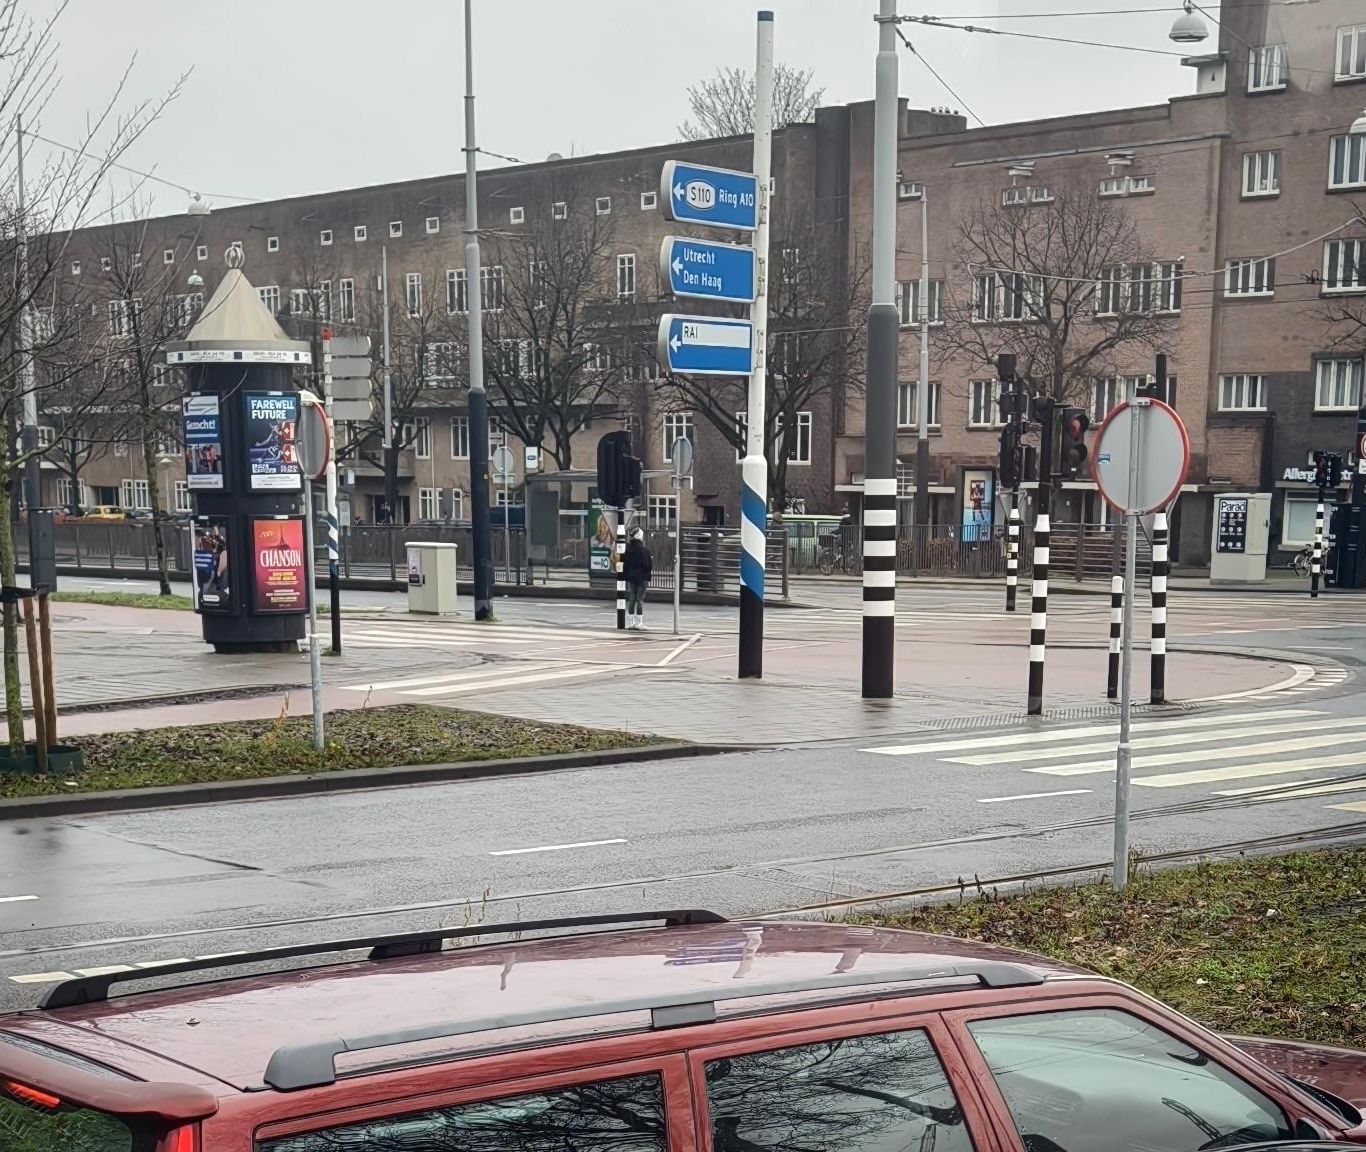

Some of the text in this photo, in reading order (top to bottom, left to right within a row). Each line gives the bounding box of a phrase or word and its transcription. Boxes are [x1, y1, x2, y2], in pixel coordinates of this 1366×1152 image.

[719, 189, 737, 208] Ring
[739, 193, 754, 207] A10
[683, 248, 715, 265] Utrecht
[683, 270, 722, 292] Den Haag
[684, 325, 698, 340] RAI
[251, 399, 294, 410] FAREWELL
[252, 410, 286, 420] FUTURE
[1283, 468, 1317, 482] Allergi
[260, 549, 302, 567] CHANSON
